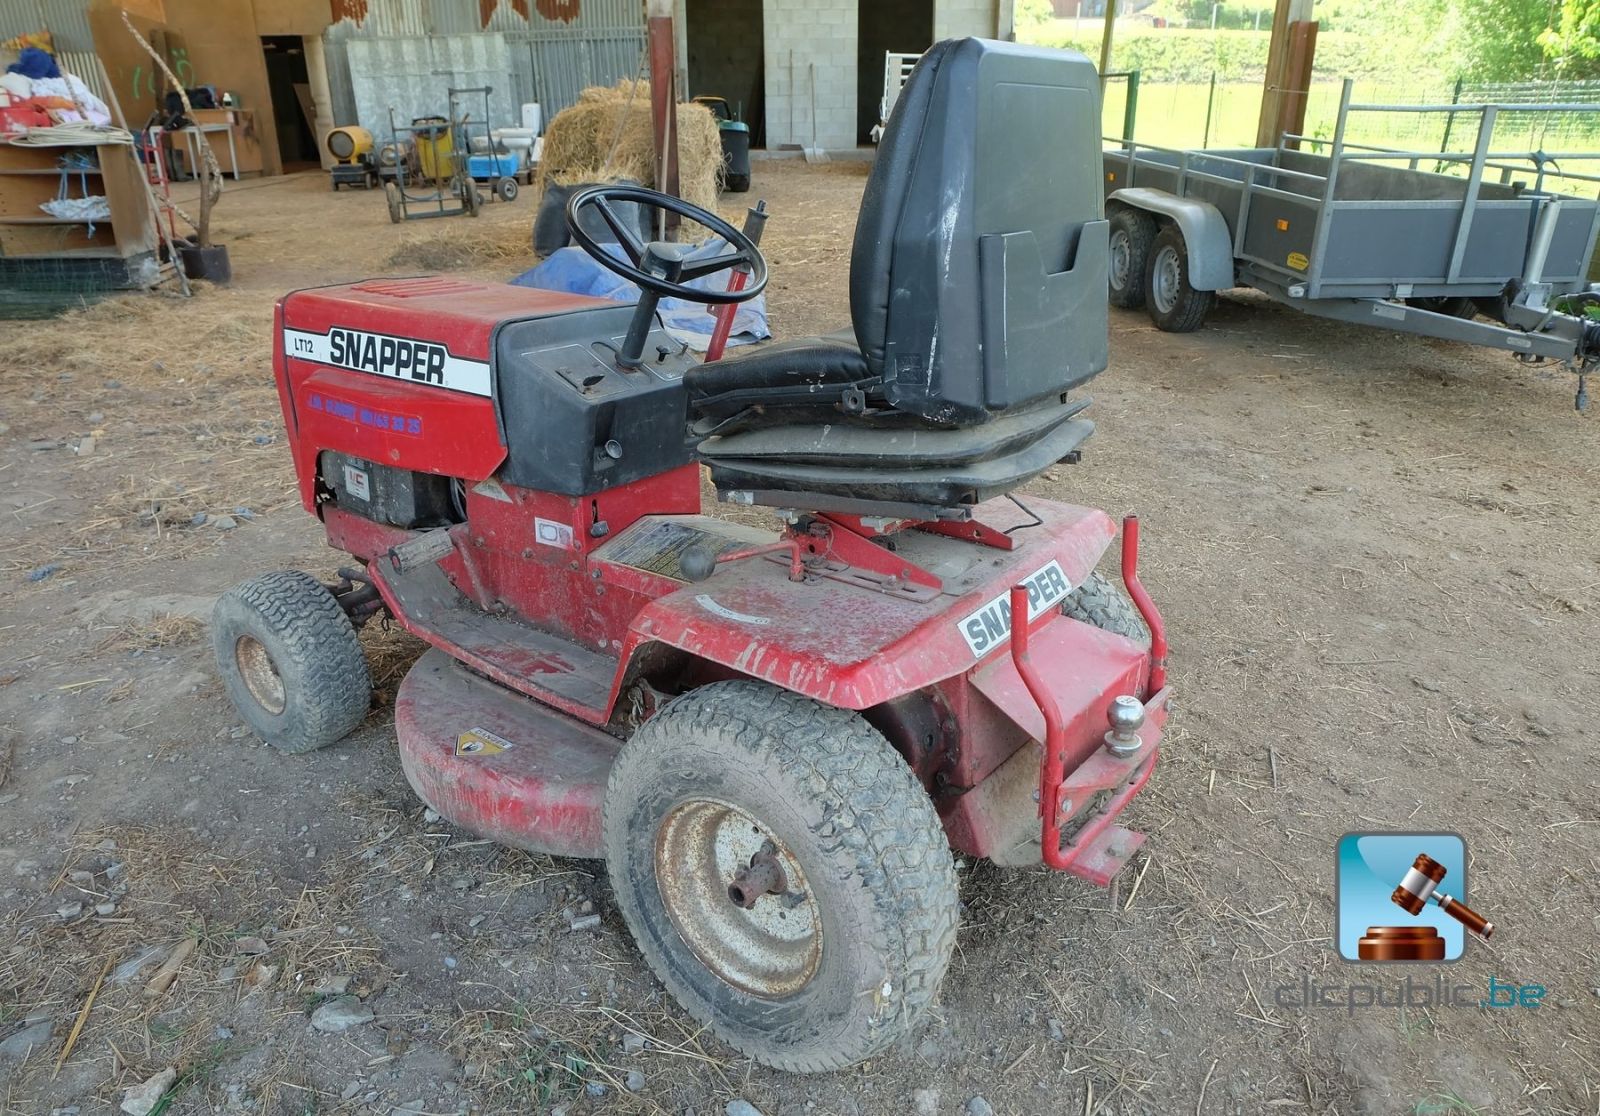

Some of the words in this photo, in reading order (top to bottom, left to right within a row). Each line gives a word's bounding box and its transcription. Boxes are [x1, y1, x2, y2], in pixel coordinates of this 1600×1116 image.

[294, 337, 314, 353] LT12
[330, 329, 445, 385] SNAPPER
[966, 565, 1067, 651] SNAPER
